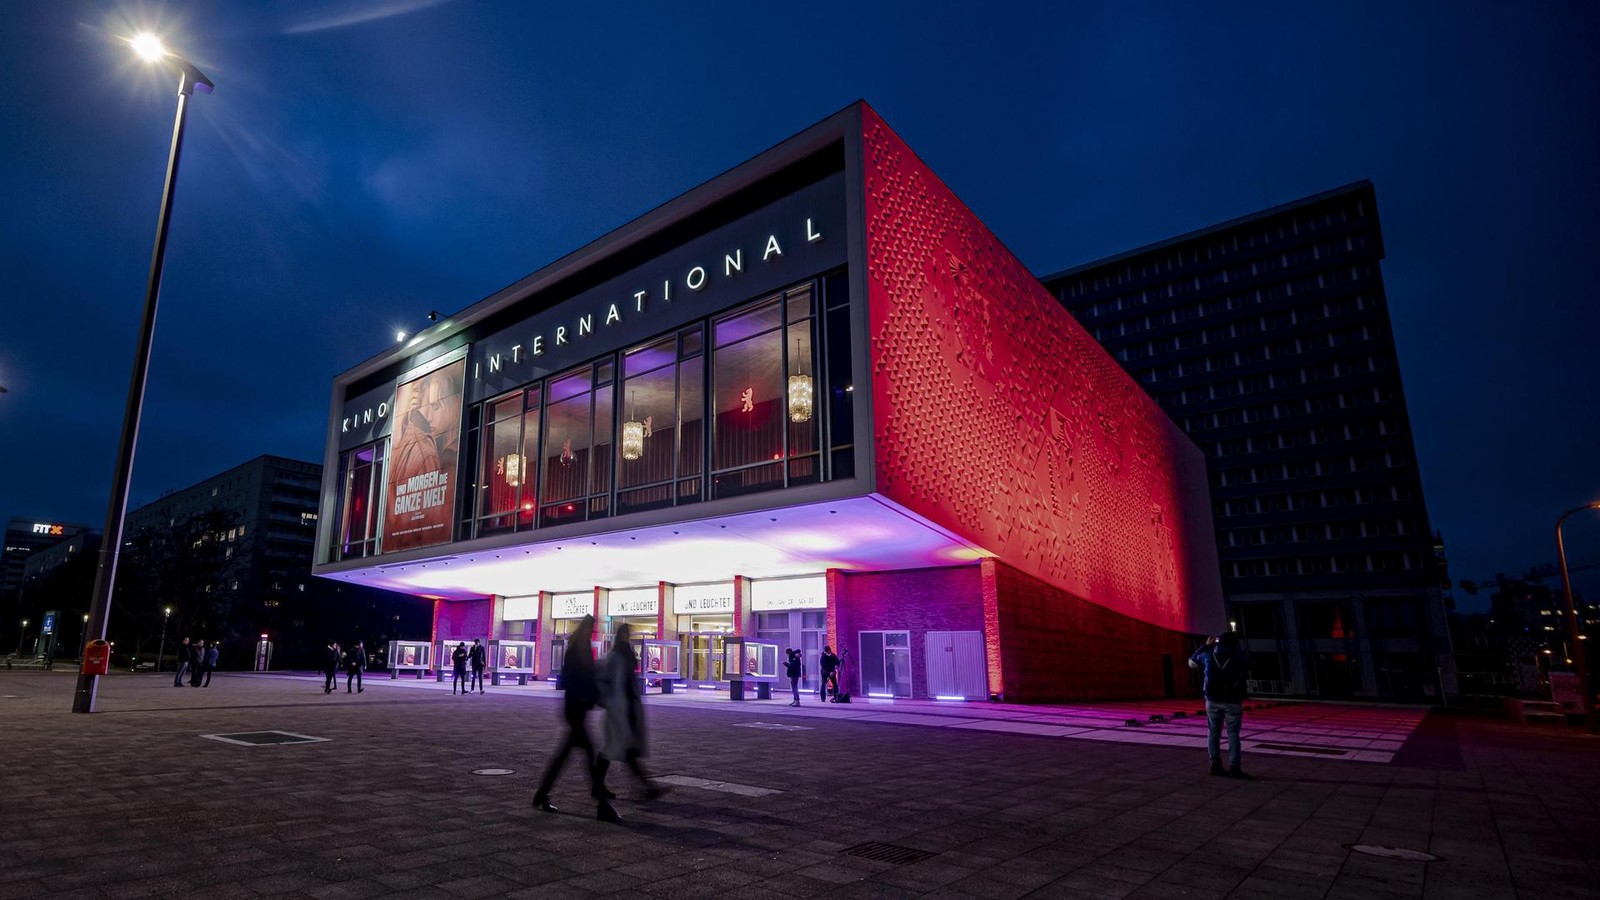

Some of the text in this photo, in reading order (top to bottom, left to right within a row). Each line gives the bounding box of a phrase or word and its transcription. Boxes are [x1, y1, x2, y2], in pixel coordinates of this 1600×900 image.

[342, 218, 821, 433] KINO INTERNATIONAL
[396, 470, 448, 496] UND MORGEN DIE
[394, 485, 447, 515] GANZE WELT
[700, 597, 731, 609] LEUCHTET
